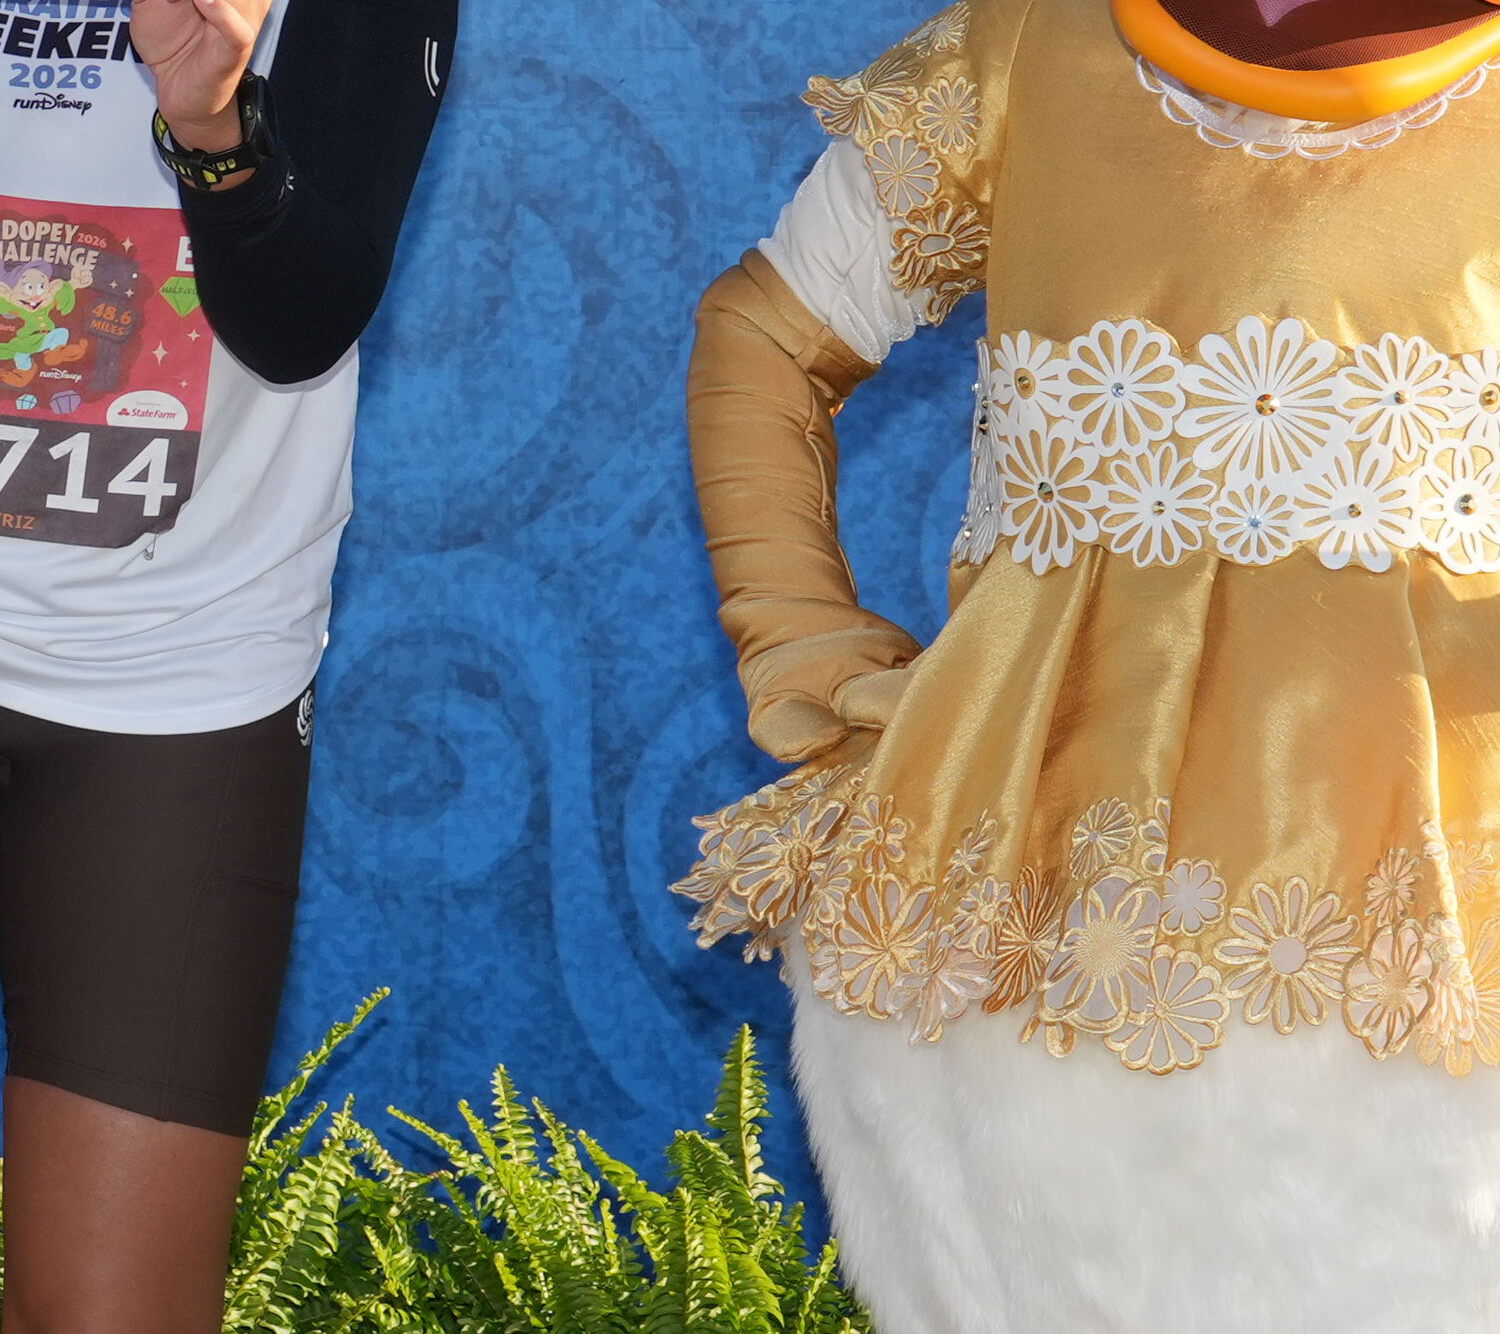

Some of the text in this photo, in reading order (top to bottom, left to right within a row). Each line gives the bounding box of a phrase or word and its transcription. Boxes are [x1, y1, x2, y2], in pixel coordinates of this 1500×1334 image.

[8, 62, 102, 90] 2026
[12, 92, 93, 117] runDisney
[1, 219, 108, 249] DOPEY 2026
[91, 302, 133, 326] 48.6
[89, 318, 127, 337] MILES
[39, 367, 83, 383] runDisney
